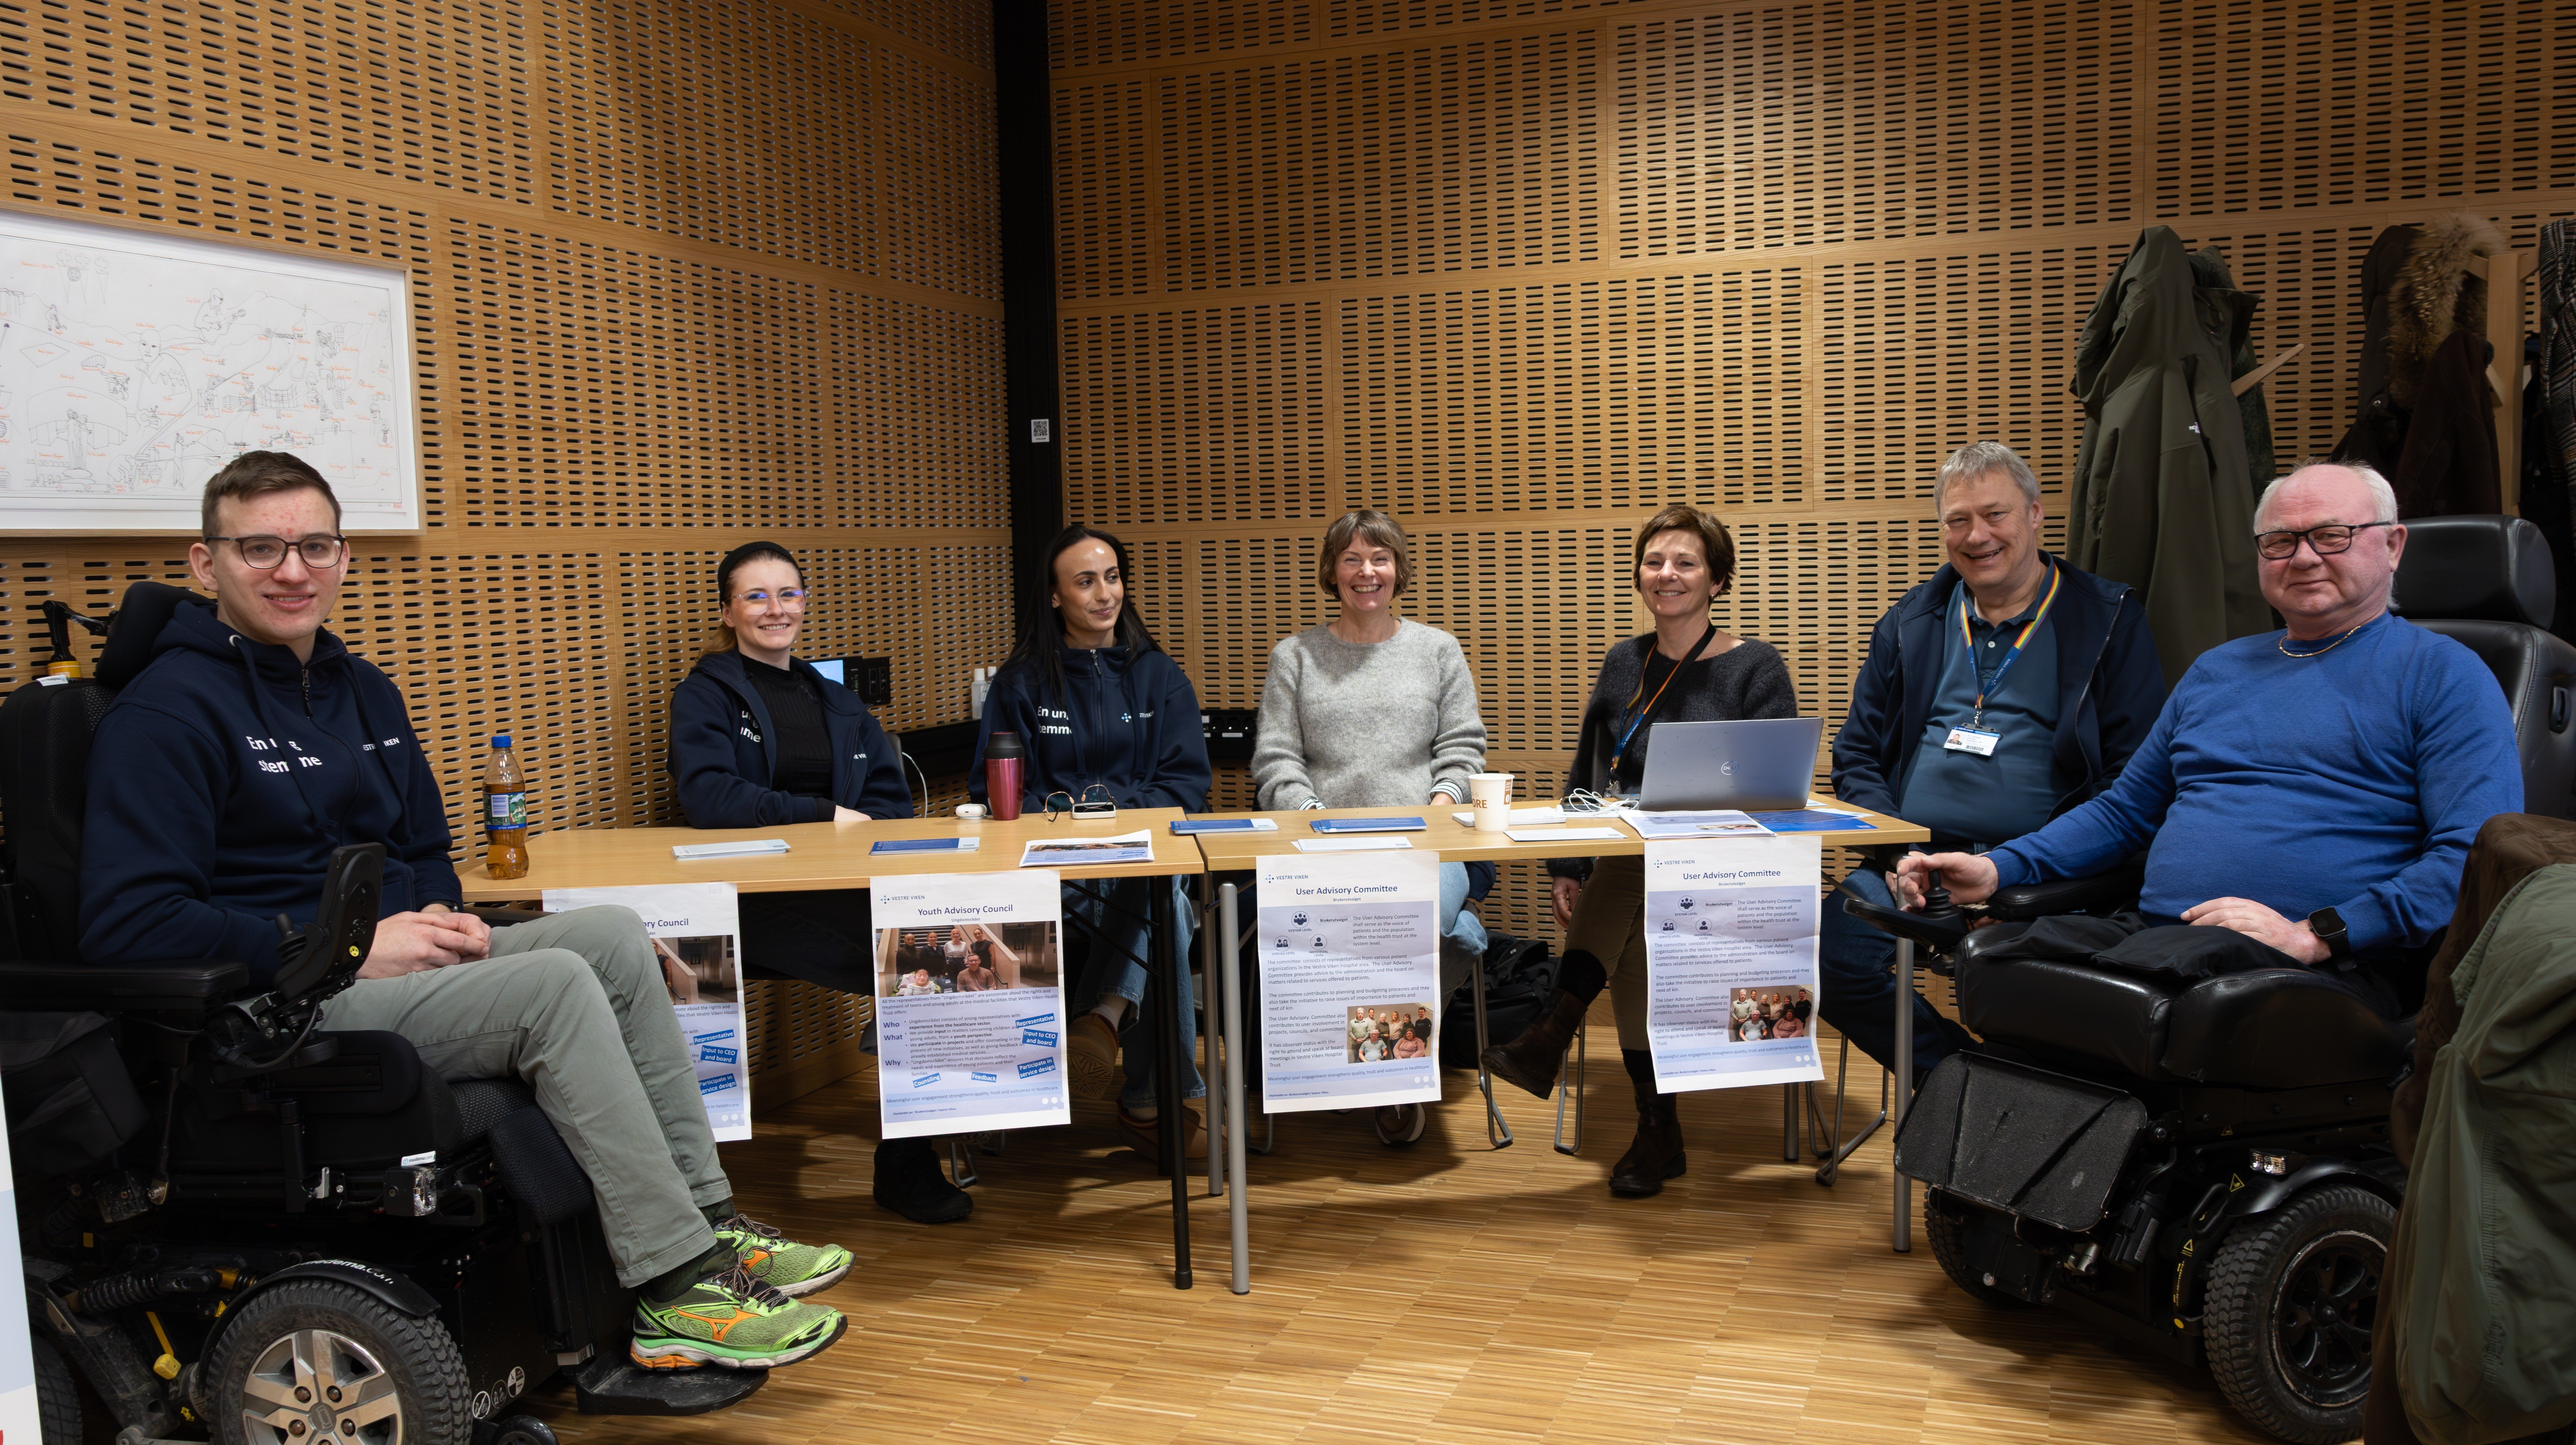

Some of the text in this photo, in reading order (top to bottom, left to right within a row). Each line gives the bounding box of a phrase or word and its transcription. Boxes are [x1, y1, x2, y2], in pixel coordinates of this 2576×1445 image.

[1037, 706, 1069, 721] En un
[1039, 724, 1072, 734] temm
[246, 736, 268, 750] En
[383, 737, 400, 747] IKEN
[1472, 798, 1487, 808] ORE
[983, 904, 1013, 912] Council
[658, 918, 688, 927] Council
[1016, 1016, 1054, 1027] Representative
[694, 1032, 734, 1043] Representative
[1019, 1060, 1046, 1070] Participate
[699, 1077, 726, 1087] Participate
[914, 1075, 940, 1086] Counsiling
